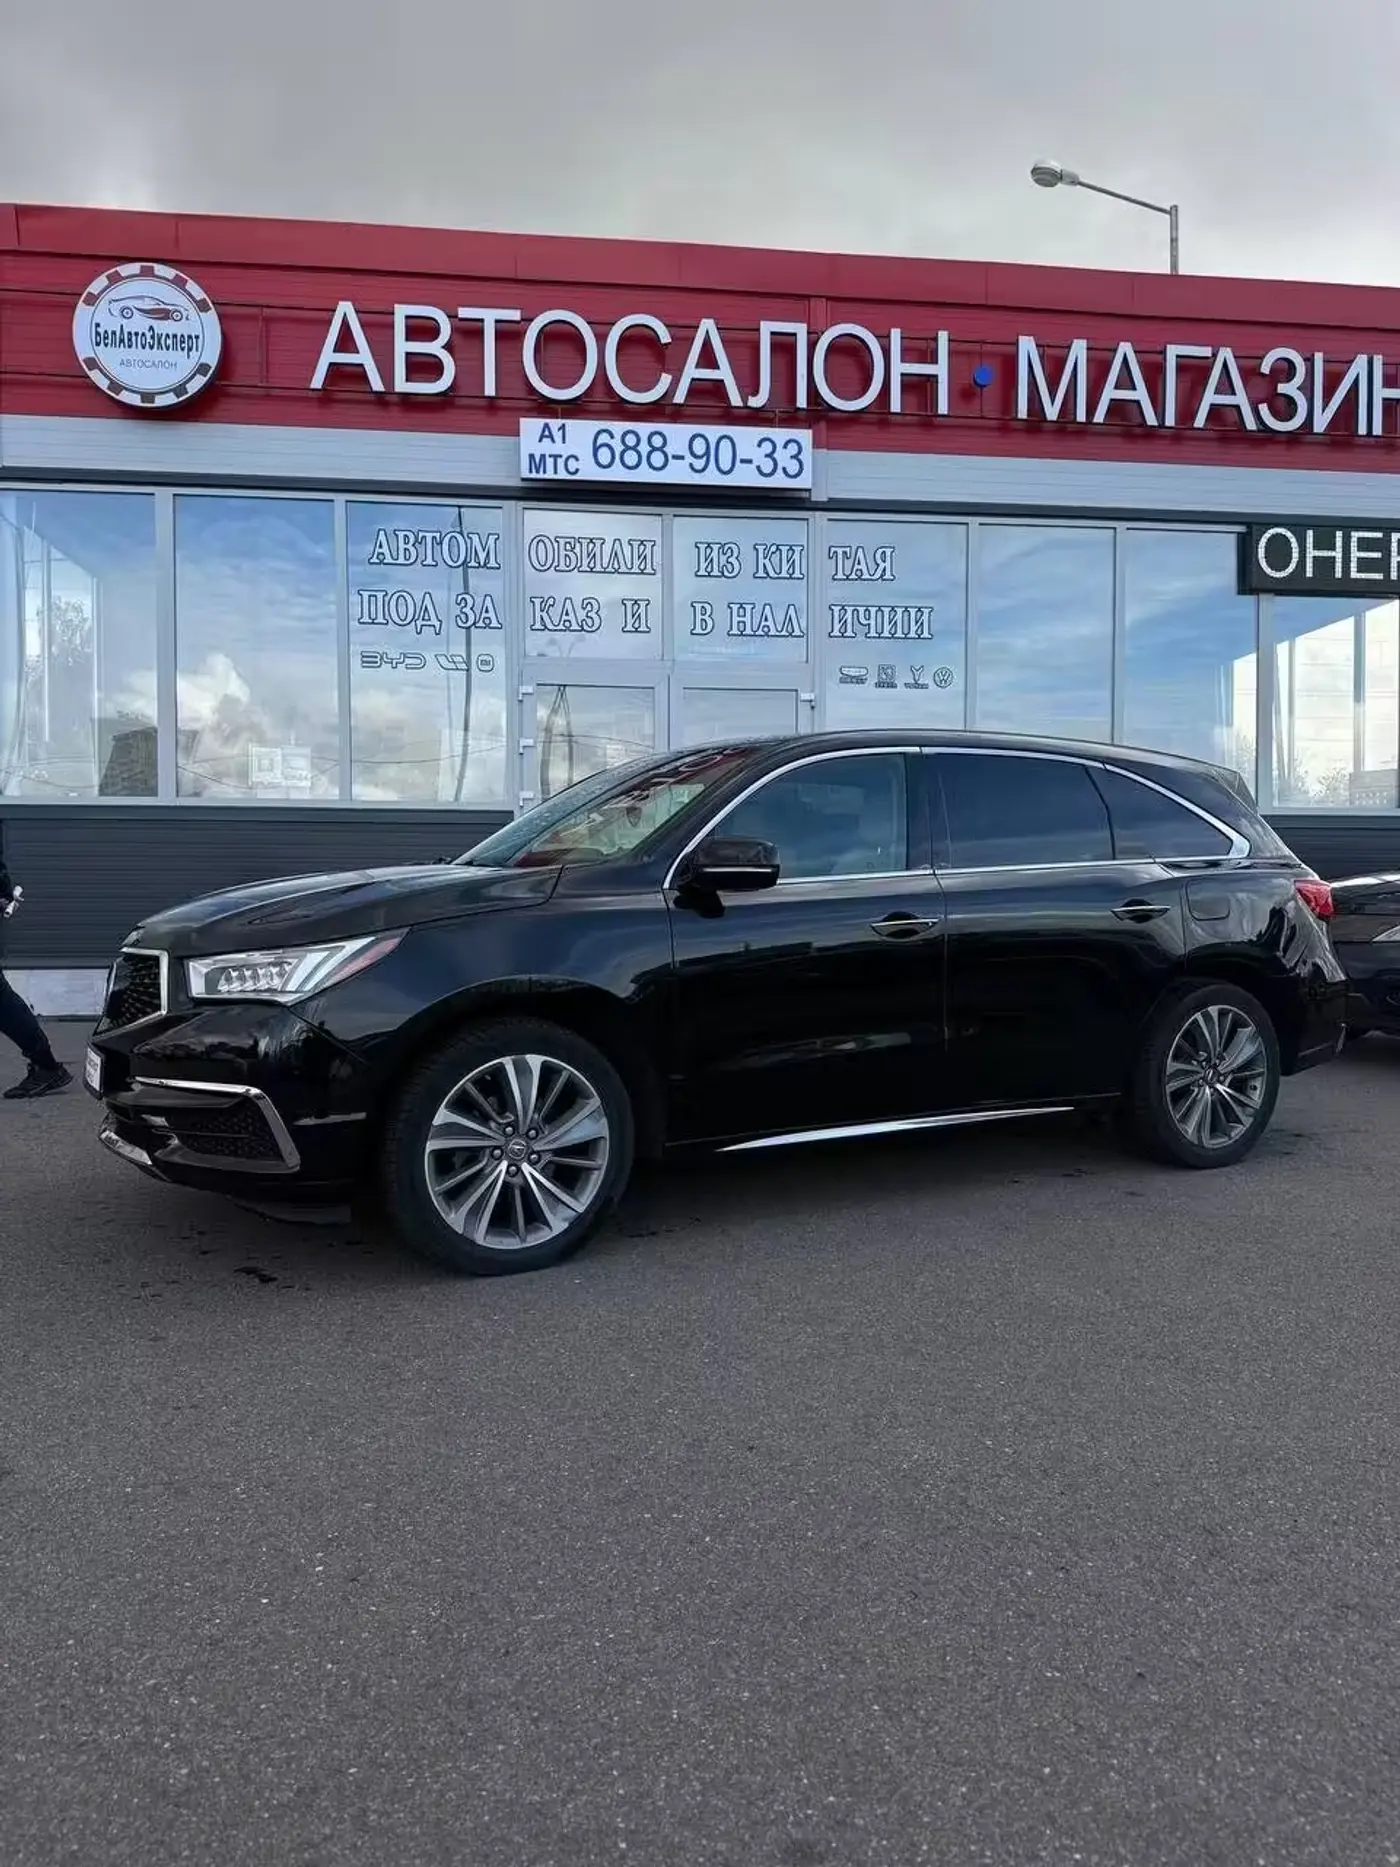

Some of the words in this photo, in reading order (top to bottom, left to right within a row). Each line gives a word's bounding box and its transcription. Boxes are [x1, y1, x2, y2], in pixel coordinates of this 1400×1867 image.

[94, 322, 201, 359] БелАвтоЭксперт
[310, 301, 949, 415] АВТОСАЛОН
[119, 359, 178, 371] АВТОСАЛОН
[538, 422, 567, 444] A1
[528, 453, 580, 475] МТС
[592, 428, 804, 479] 688-90-33
[694, 541, 742, 578] ИЗ
[358, 589, 442, 635] ПОД
[621, 598, 651, 633] И
[690, 600, 715, 635] В
[360, 651, 426, 670] BYD
